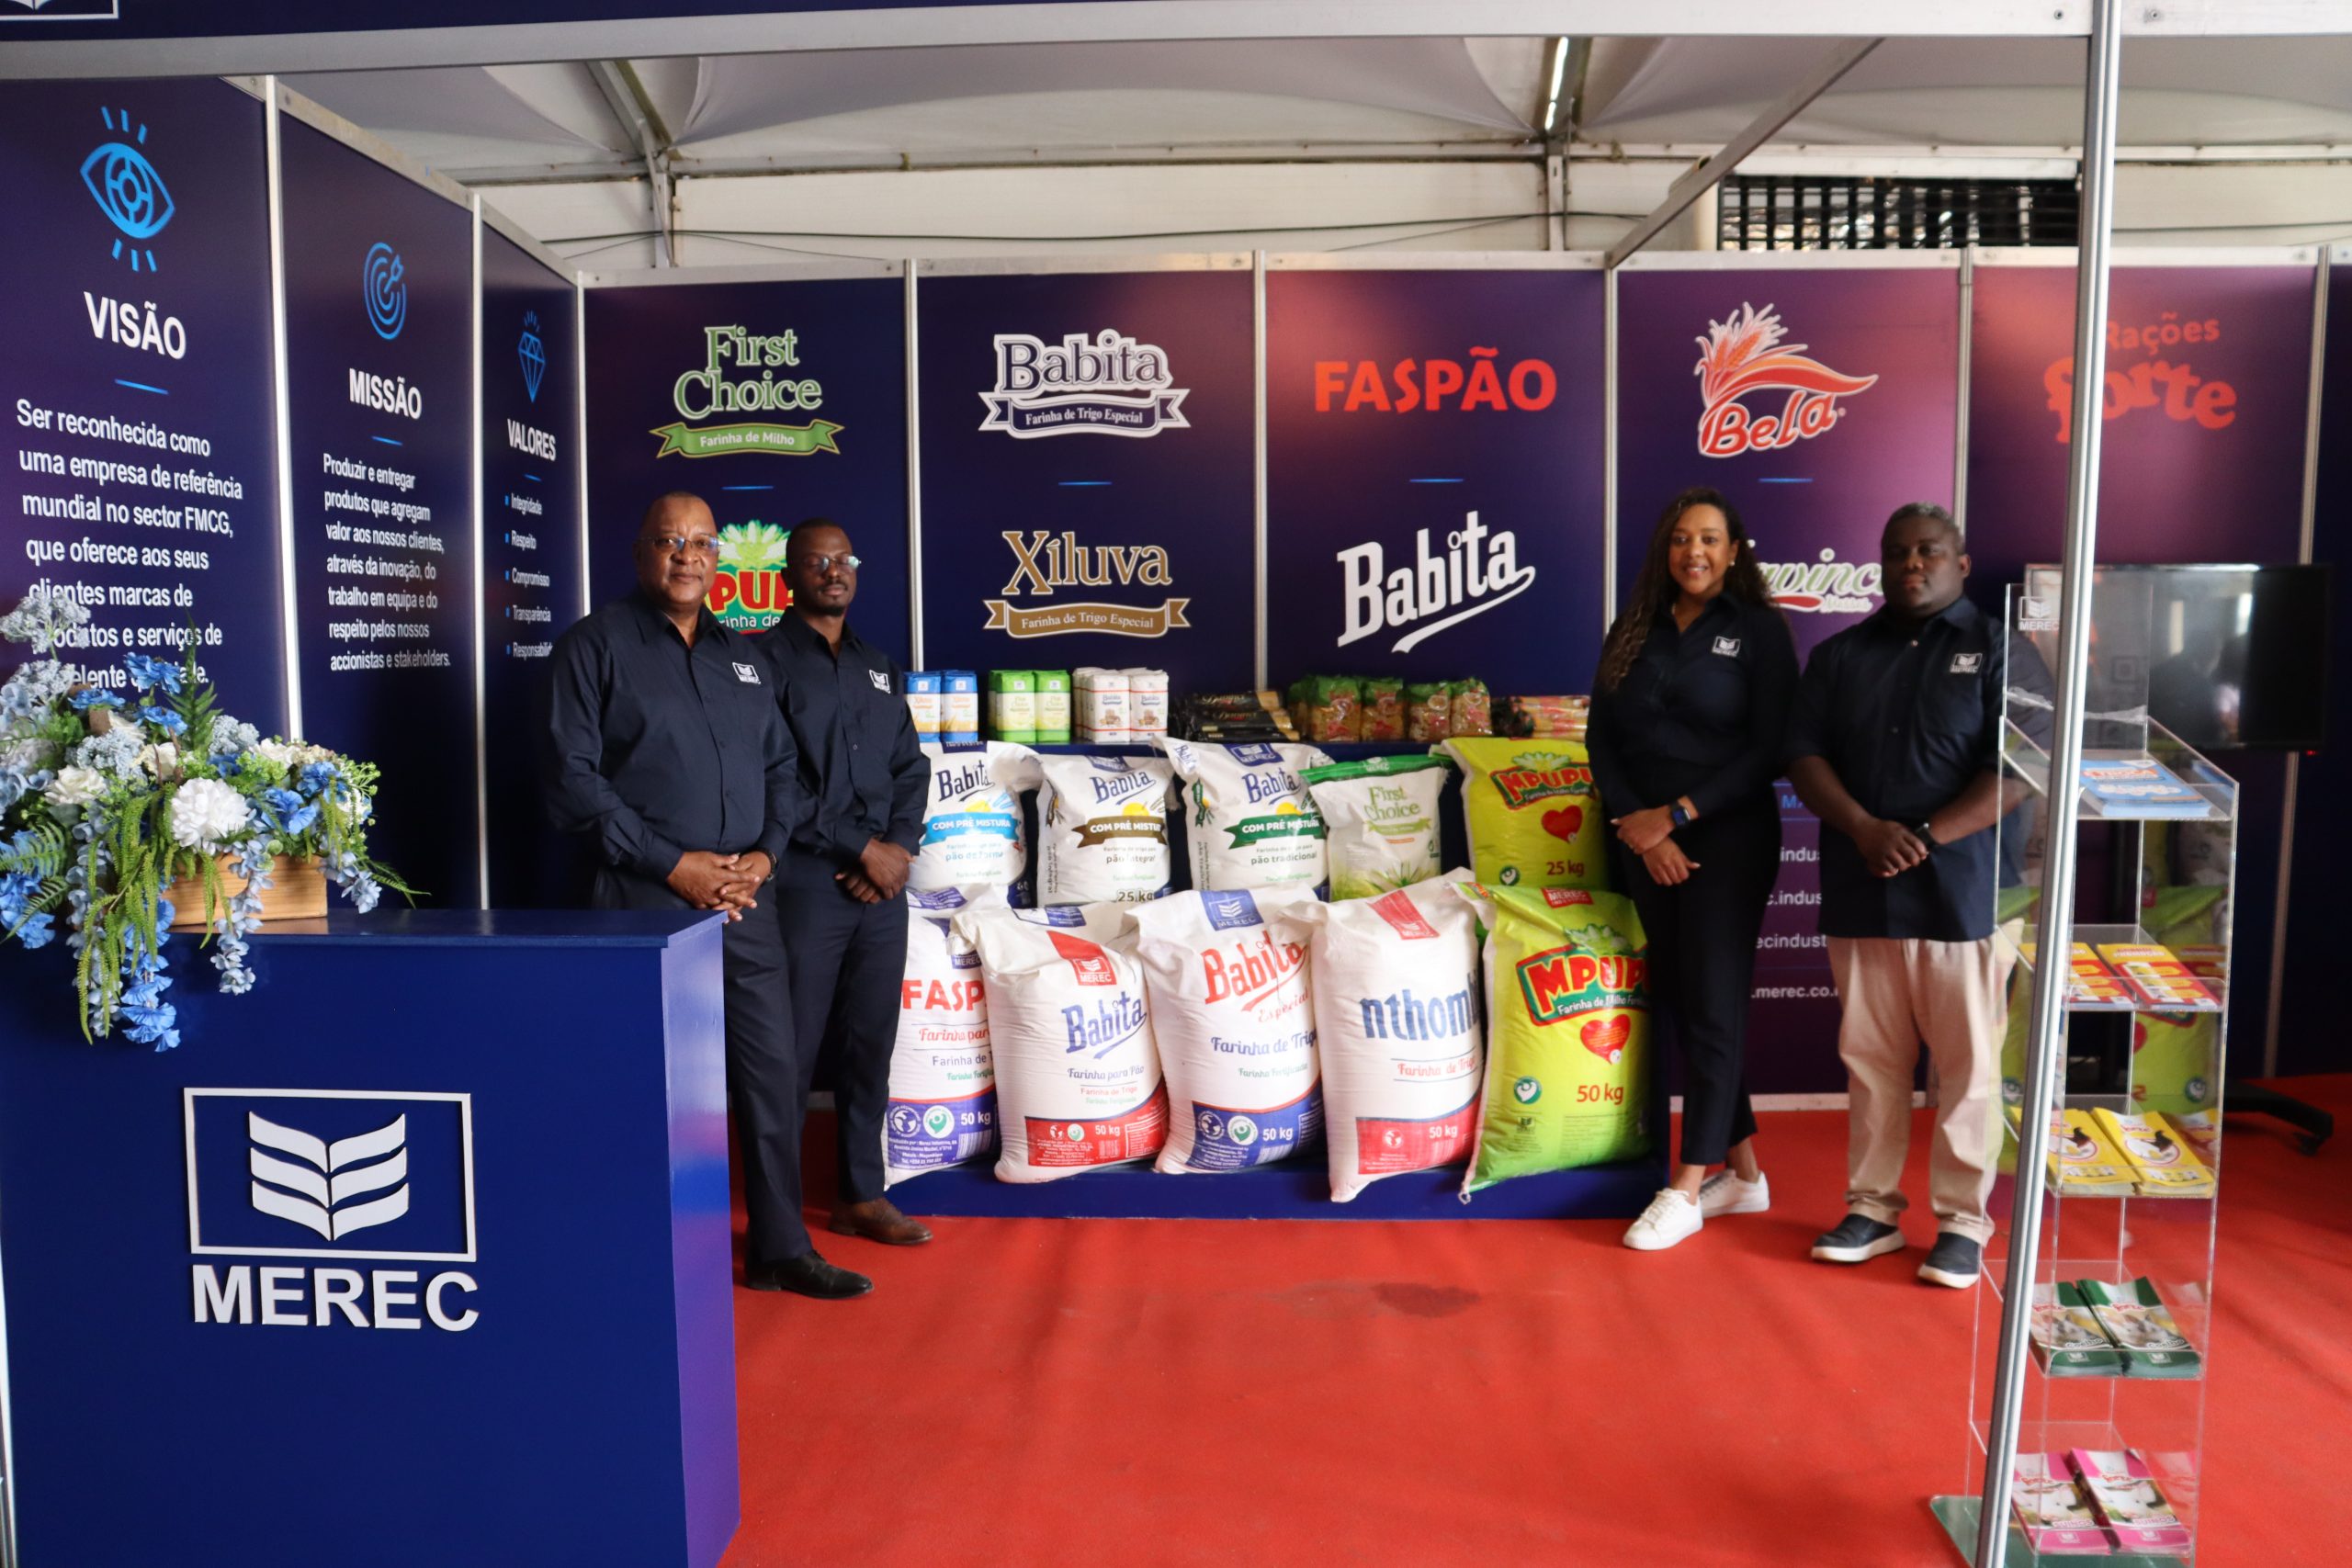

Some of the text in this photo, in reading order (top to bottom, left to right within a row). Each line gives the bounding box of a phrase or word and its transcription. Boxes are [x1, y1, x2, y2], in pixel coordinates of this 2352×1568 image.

[83, 291, 187, 360] VISÃO
[704, 324, 800, 374] First
[996, 331, 1169, 396] Babita
[1315, 345, 1557, 412] FASPÃO
[349, 368, 422, 419] MISSÃO
[673, 369, 822, 420] Choice
[1025, 406, 1143, 426] Farinha de Trigo Especial
[1699, 389, 1838, 457] Bela
[17, 398, 211, 457] Ser reconhecida como
[700, 429, 795, 447] Farinha de Milho
[507, 418, 556, 461] VALORES
[19, 449, 243, 500] uma empresa de referência
[323, 452, 414, 493] Produzir e entregar
[324, 489, 430, 525] produtos que agregam
[511, 492, 542, 515] Integridade
[22, 493, 234, 538] mundial no sector FMCG,
[326, 522, 445, 554] valor aos nossos clientes,
[511, 530, 537, 551] Respeito
[26, 536, 209, 570] que oferece aos seus
[327, 554, 435, 582] através da inovação, do
[512, 567, 549, 589] Compromisso
[1337, 511, 1536, 653] Babita
[108, 585, 171, 607] marcas
[174, 582, 193, 607] de
[328, 586, 437, 613] trabalho em equipa e do
[513, 604, 550, 625] Transparência
[762, 615, 781, 627] de
[1021, 611, 1154, 630] Farinha de Trigo Especial
[123, 622, 222, 651] e serviços de
[329, 618, 429, 642] respeito pelos nossos
[2019, 620, 2060, 632] MEREC
[331, 649, 450, 671] accionistas e stakeholders.
[1241, 768, 1302, 806] Babita
[1368, 785, 1408, 805] First
[1363, 802, 1420, 821] Choice
[932, 821, 954, 831] COM
[956, 817, 974, 829] PRÉ
[1090, 823, 1113, 833] COM
[1114, 819, 1132, 830] PRÉ
[1242, 818, 1319, 833] COM PRÉ MISTURA
[1250, 851, 1317, 865] pão tradicional
[1546, 860, 1585, 877] 25 kg
[1118, 890, 1155, 902] 25 kg
[1217, 917, 1256, 928] MEREC
[1080, 974, 1112, 983] MEREC
[1200, 930, 1309, 1011] Babita
[901, 979, 986, 1011] FASP
[1525, 955, 1645, 1016] MPUP
[1259, 987, 1309, 1022] Especial
[1359, 970, 1480, 1042] nthom
[1557, 993, 1626, 1015] Farinha de Milho
[919, 1028, 966, 1042] Farinha
[1061, 991, 1147, 1059] Babita
[1211, 1035, 1271, 1055] Farinha
[1273, 1039, 1288, 1052] de
[933, 1055, 972, 1066] Farinha
[975, 1054, 987, 1064] de
[1397, 1063, 1441, 1077] Farinha
[1446, 1062, 1456, 1073] de
[1068, 1065, 1144, 1081] Farinha para Pão
[1238, 1067, 1270, 1078] Farinha
[1080, 1086, 1137, 1096] Farinha de Trigo
[1577, 1082, 1624, 1105] 50 kg
[961, 1111, 991, 1125] 50 kg
[1095, 1125, 1120, 1136] 50 kg
[1262, 1127, 1294, 1141] 50 kg
[1429, 1124, 1458, 1139] 50 kg
[192, 1264, 480, 1332] MEREC
